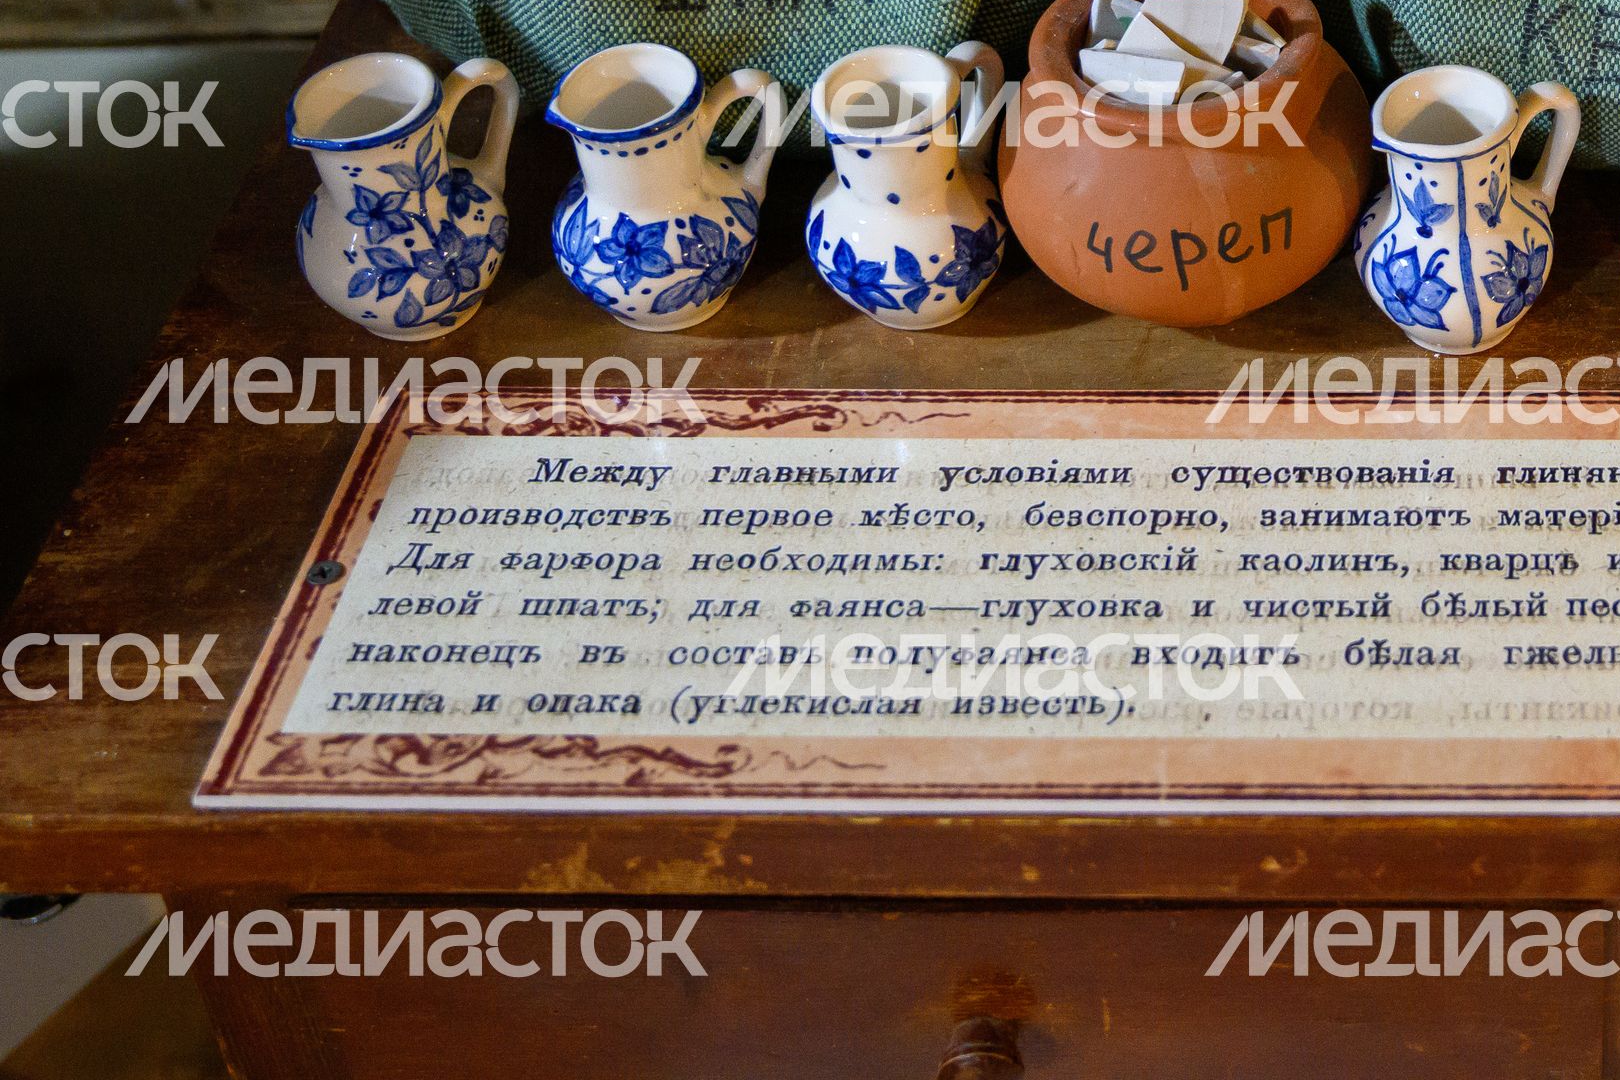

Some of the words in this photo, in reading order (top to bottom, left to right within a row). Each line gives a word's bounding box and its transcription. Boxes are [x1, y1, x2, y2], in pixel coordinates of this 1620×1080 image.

[1086, 208, 1294, 291] череп
[527, 457, 673, 492] Между
[708, 465, 899, 486] главными
[407, 507, 672, 534] производствъ
[699, 508, 833, 535] первое
[1024, 501, 1228, 536] безспорно,
[1259, 509, 1471, 527] занимаютъ
[385, 542, 474, 576] Для
[499, 552, 661, 580] фарфора
[688, 545, 944, 576] необходимы:
[1238, 553, 1410, 578] каолинъ,
[1440, 553, 1579, 580] кварцъ
[367, 590, 483, 616] левой
[518, 598, 662, 624] шпатъ;
[687, 599, 760, 622] для
[1191, 600, 1215, 618] и
[1243, 592, 1392, 619] чистый
[346, 642, 541, 669] наконецъ
[578, 645, 626, 665] въ
[667, 645, 823, 667] составъ
[852, 644, 1092, 678] полуфаянса
[1130, 646, 1301, 671] входитъ
[327, 692, 445, 715] глина
[471, 694, 500, 714] и
[526, 693, 641, 716] опака
[670, 685, 922, 725] (углекислая
[950, 688, 1136, 726] известь).
